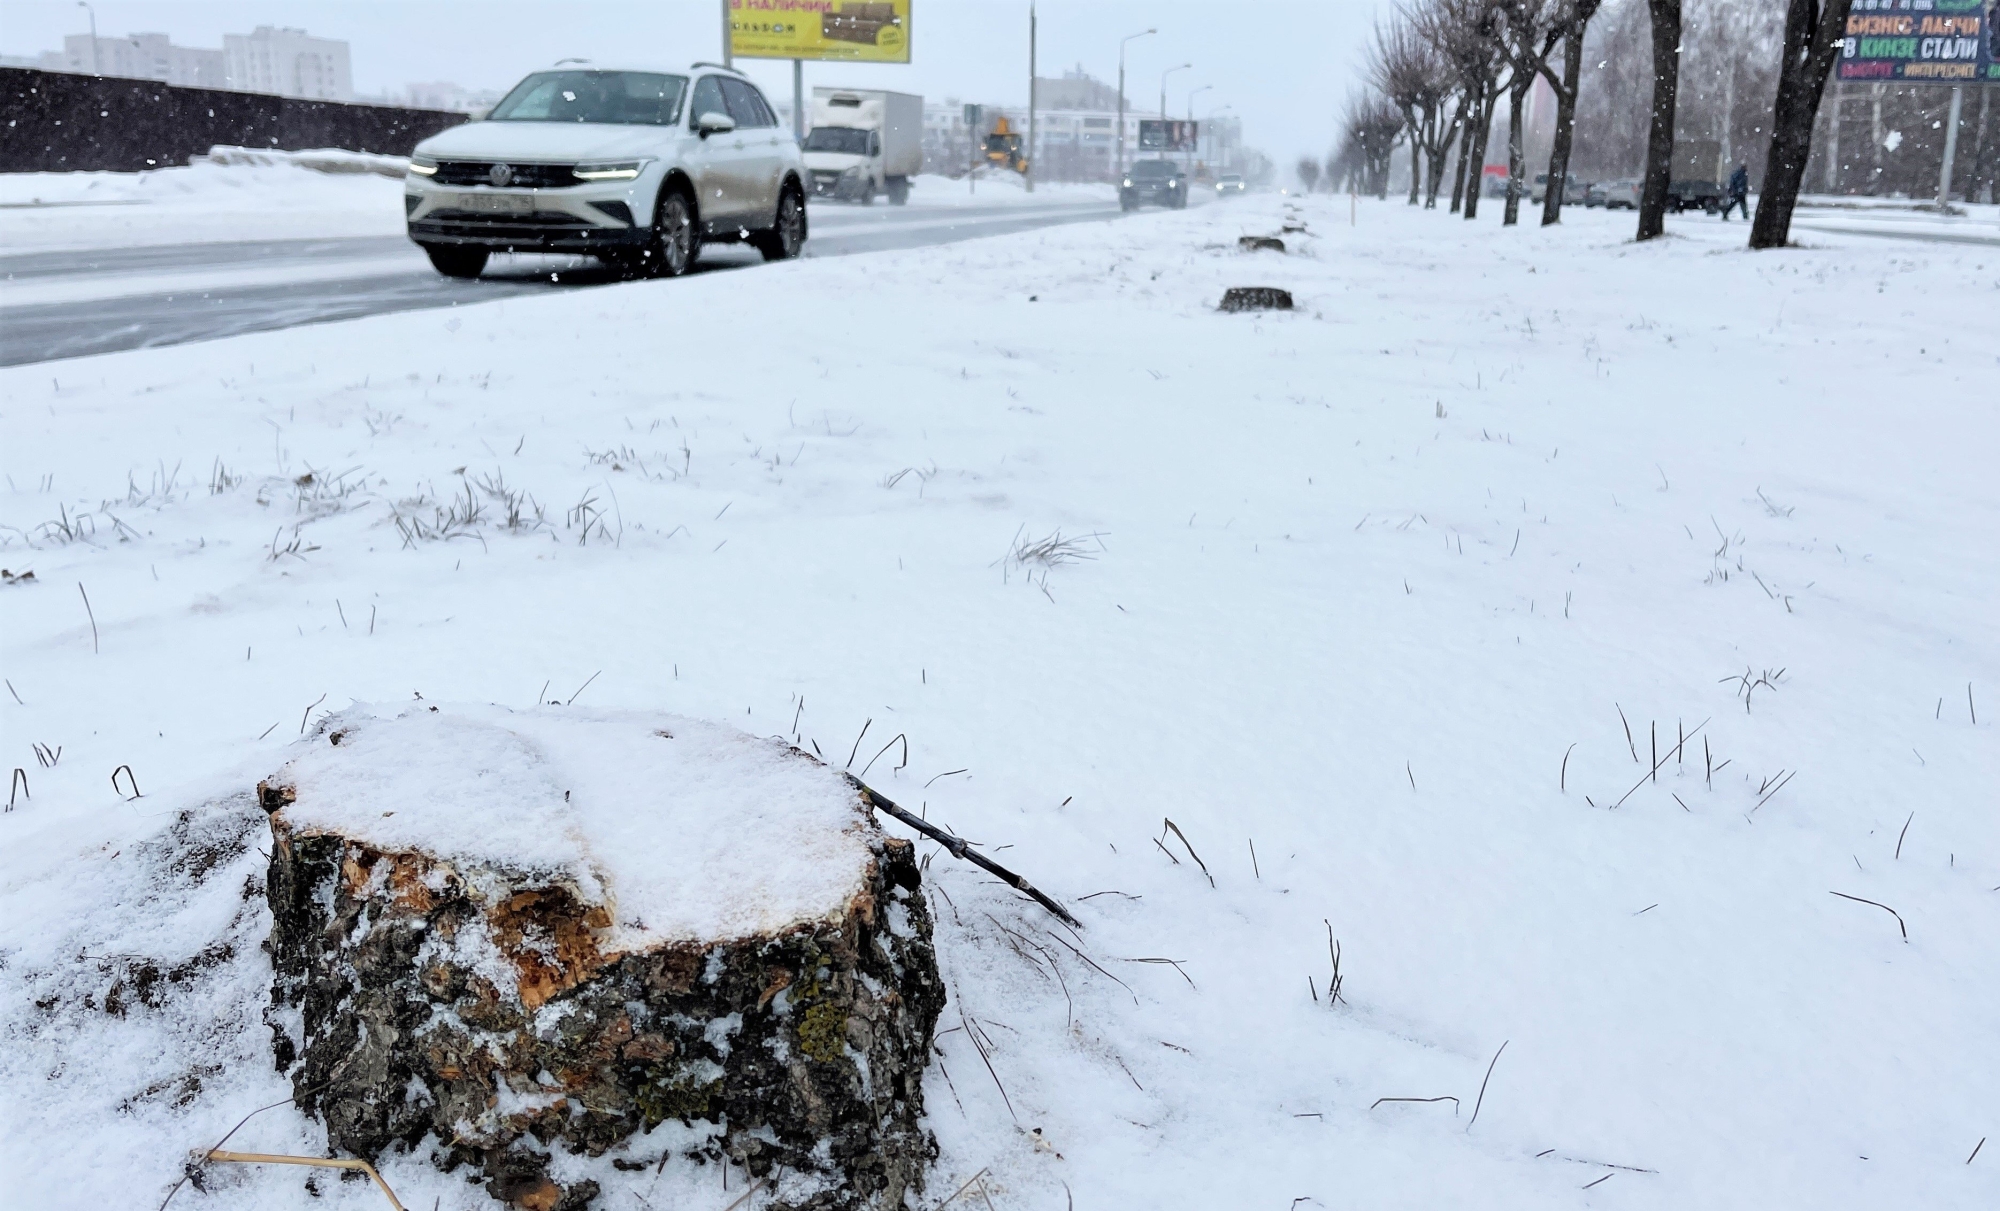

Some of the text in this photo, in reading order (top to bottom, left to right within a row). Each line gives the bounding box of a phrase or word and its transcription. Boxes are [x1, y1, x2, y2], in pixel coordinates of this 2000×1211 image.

[1843, 37, 1978, 59] В КИНЗЕ СТАЛИ
